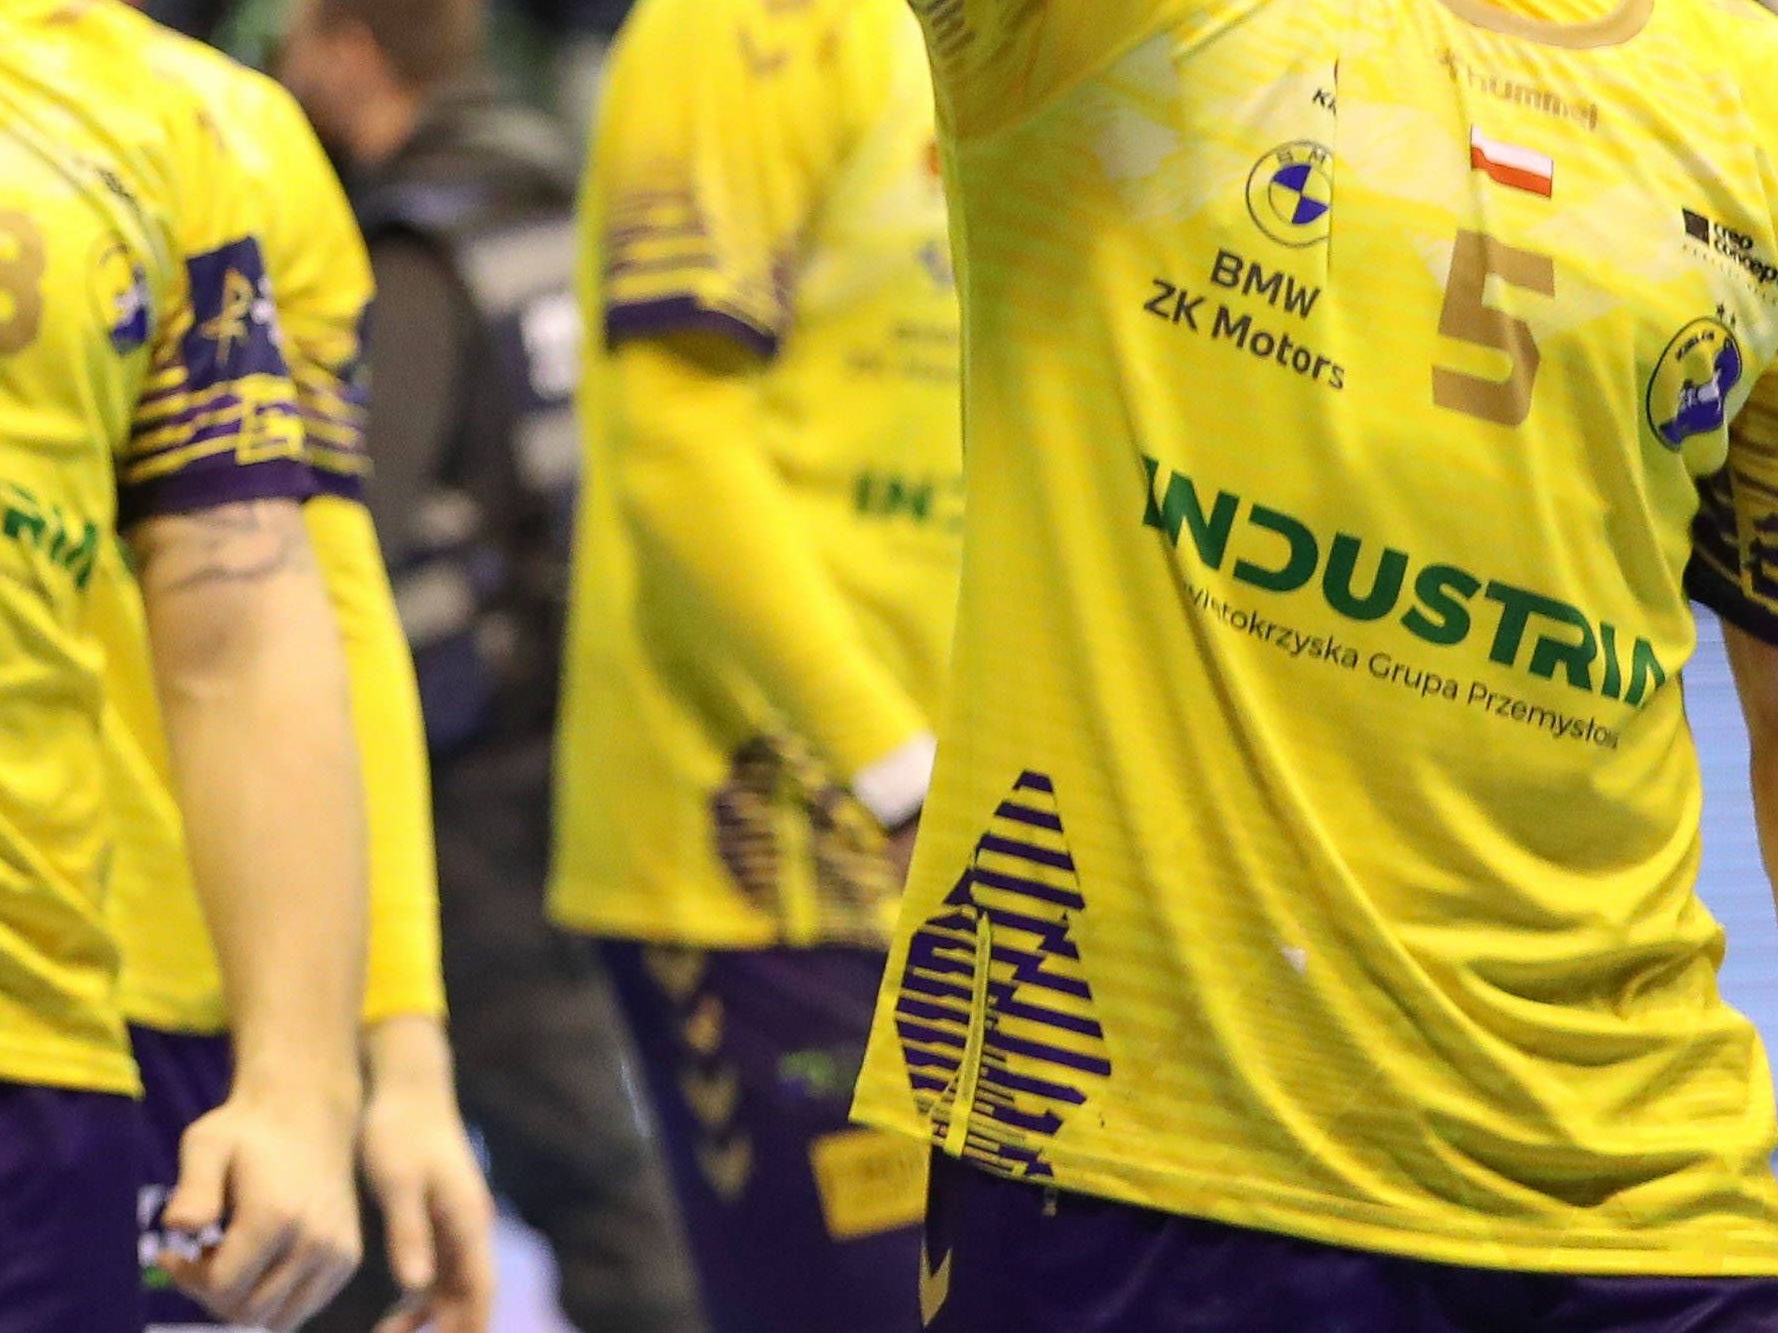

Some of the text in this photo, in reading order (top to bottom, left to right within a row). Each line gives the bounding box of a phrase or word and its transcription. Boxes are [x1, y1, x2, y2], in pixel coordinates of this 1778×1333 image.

[1208, 247, 1320, 319] BMW
[1713, 239, 1778, 284] concep
[1142, 277, 1346, 392] ZK Motors
[1431, 228, 1556, 427] 5
[1368, 651, 1460, 701] Grupa
